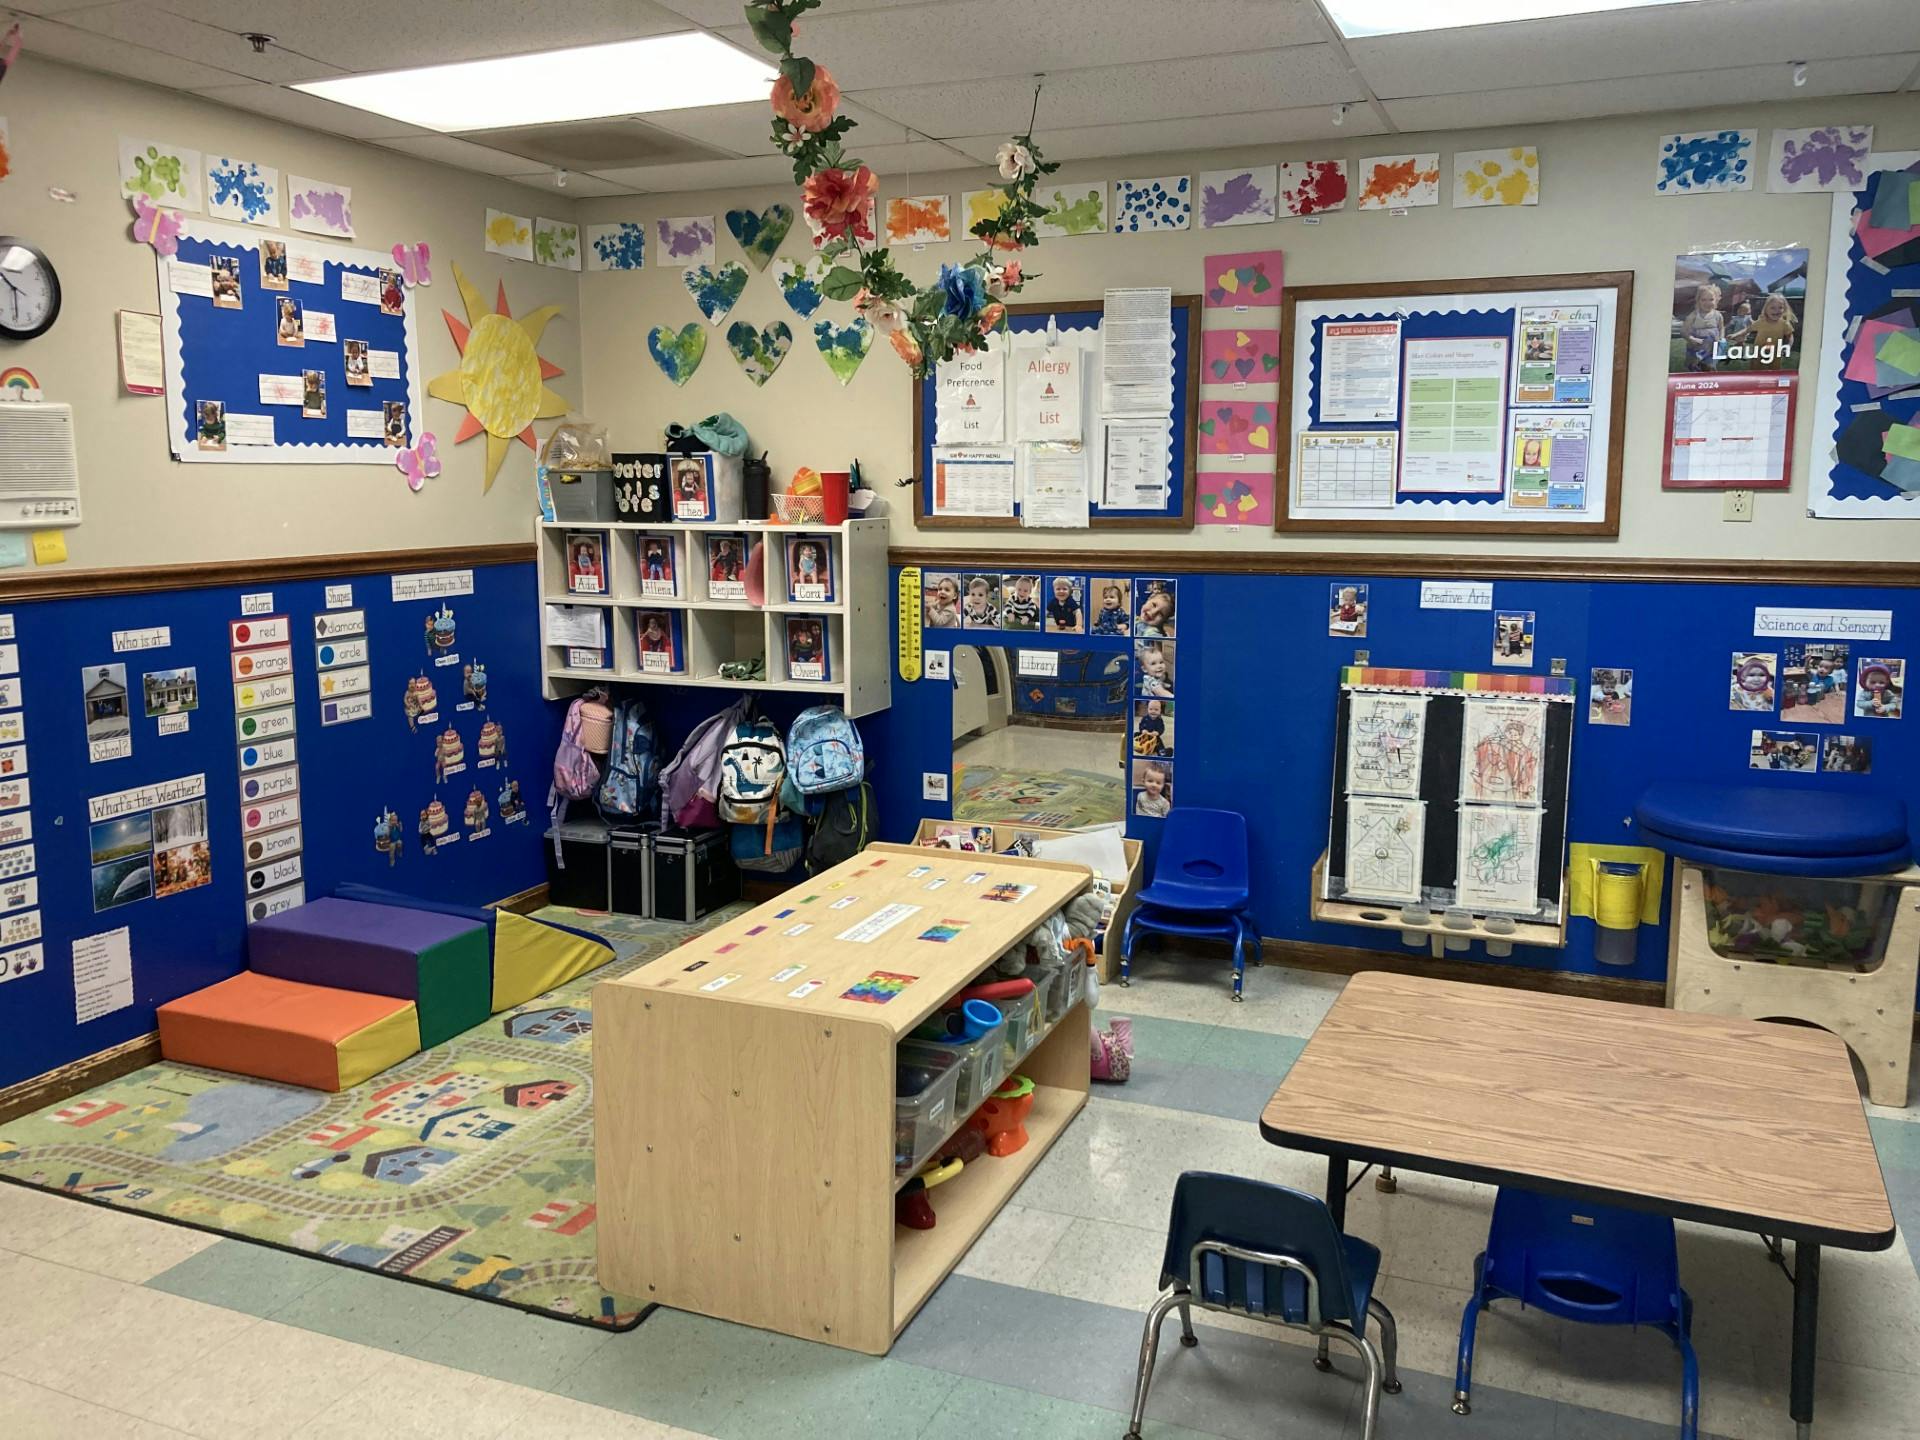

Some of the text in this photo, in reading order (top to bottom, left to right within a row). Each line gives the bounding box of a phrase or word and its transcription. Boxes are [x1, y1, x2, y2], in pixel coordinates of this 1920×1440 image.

[1712, 338, 1792, 364] Laugh
[960, 361, 983, 372] Food
[1028, 360, 1072, 375] Allergy
[1675, 381, 1720, 390] June 2024
[963, 421, 980, 430] List
[1039, 411, 1061, 424] List
[679, 503, 703, 517] Theo
[418, 577, 448, 594] Birthday
[799, 586, 821, 599] Cora
[244, 595, 272, 613] Colors
[327, 588, 352, 604] Shapes
[1423, 587, 1491, 605] Creative Arts
[259, 624, 276, 638] red
[327, 617, 364, 634] diamond
[1758, 614, 1888, 640] Science and Sensory
[113, 632, 138, 651] Who
[339, 644, 361, 660] circle
[255, 656, 289, 670] orange
[1020, 654, 1056, 674] Library
[341, 675, 361, 689] star
[260, 683, 288, 702] yellow
[339, 700, 368, 720] square
[159, 714, 188, 734] Home?
[260, 715, 289, 734] green
[92, 741, 129, 761] School?
[263, 746, 284, 761] blue
[1, 783, 20, 793] five
[262, 774, 293, 794] purple
[91, 777, 202, 818] What's the Weather?
[268, 806, 288, 824] pink
[0, 819, 14, 829] six
[266, 833, 296, 851] brown
[272, 863, 298, 880] black
[4, 882, 28, 896] eight
[269, 897, 291, 916] grey
[11, 915, 30, 926] nine
[14, 950, 32, 961] ten
